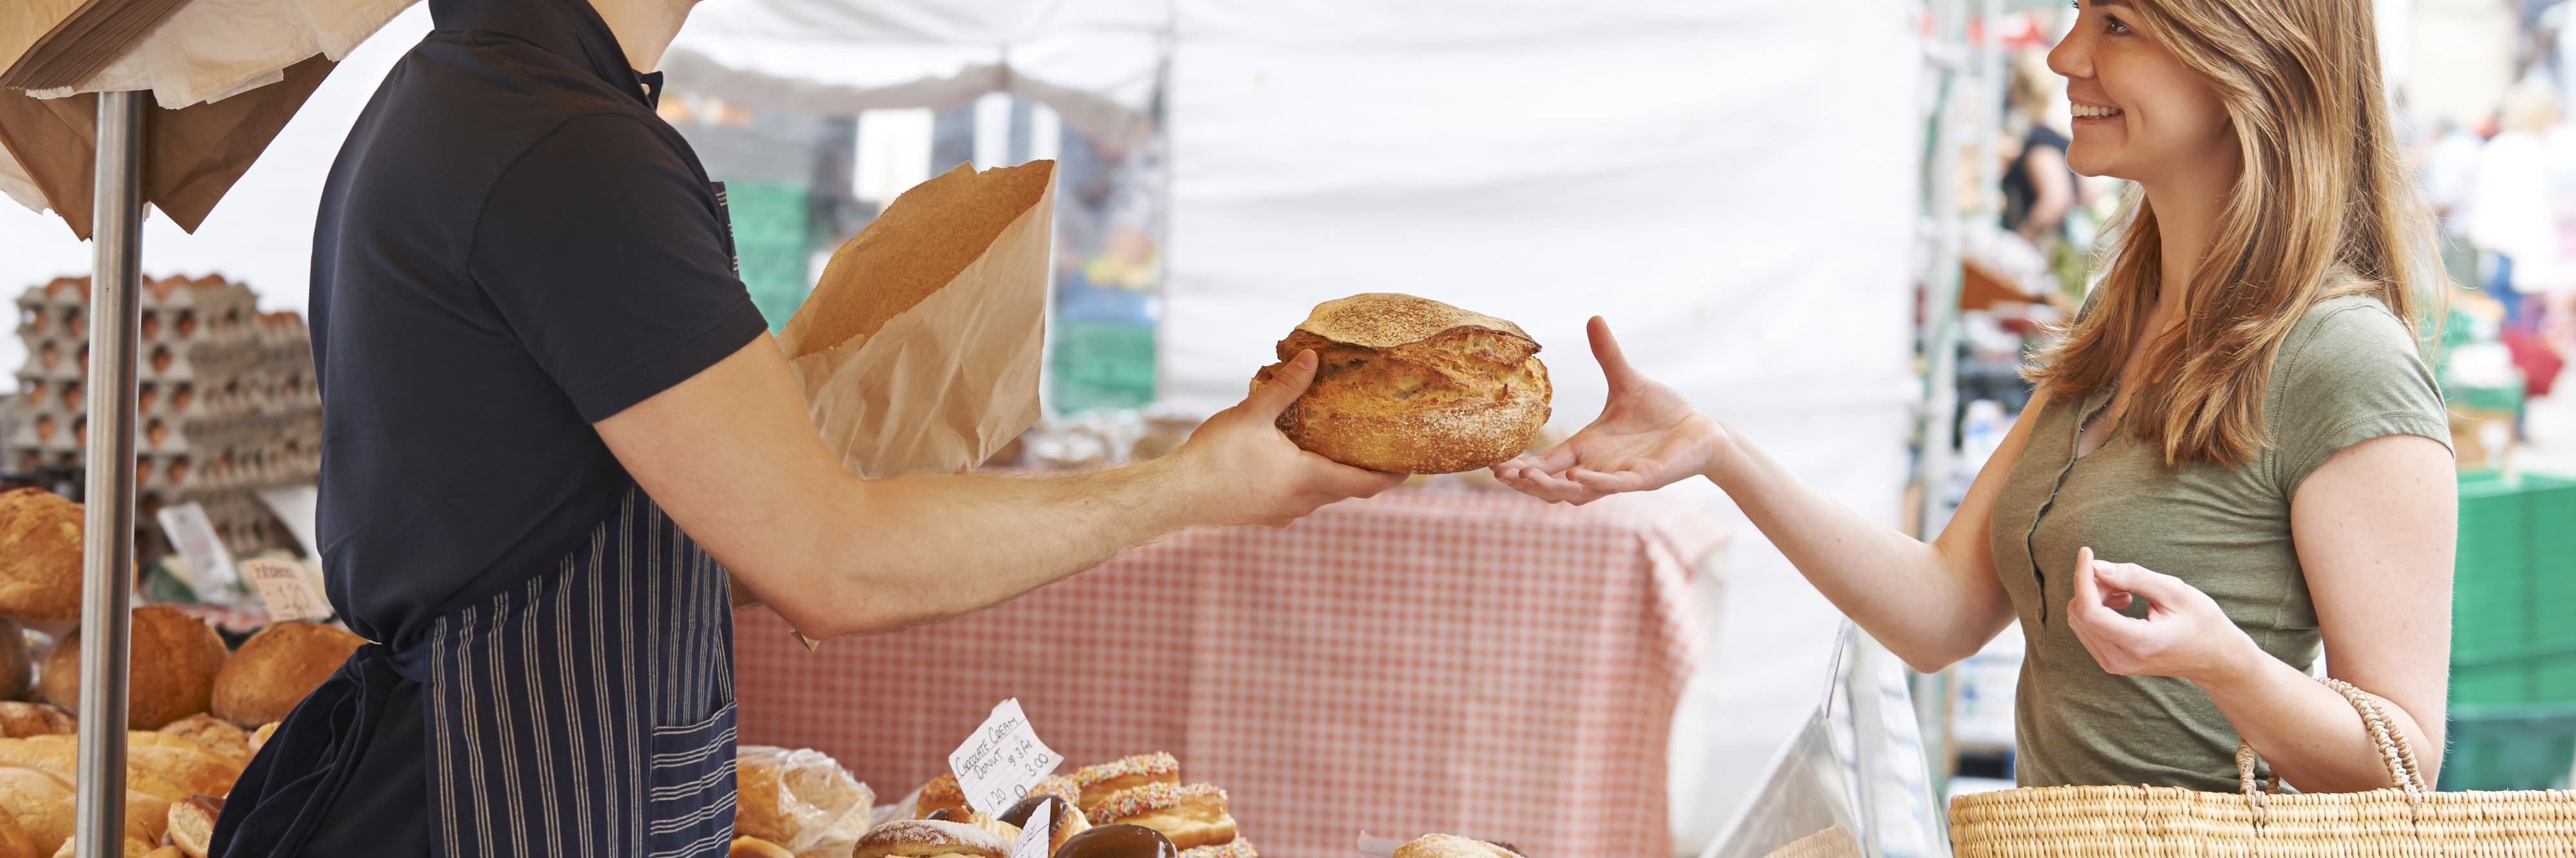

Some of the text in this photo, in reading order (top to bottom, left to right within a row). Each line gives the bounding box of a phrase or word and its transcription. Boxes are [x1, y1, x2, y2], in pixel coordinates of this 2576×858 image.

[956, 717, 1018, 777] CHOCOLATE CREAM
[1016, 747, 1024, 759] 3
[974, 749, 1002, 780] DONUT
[1025, 753, 1048, 778] 3.00
